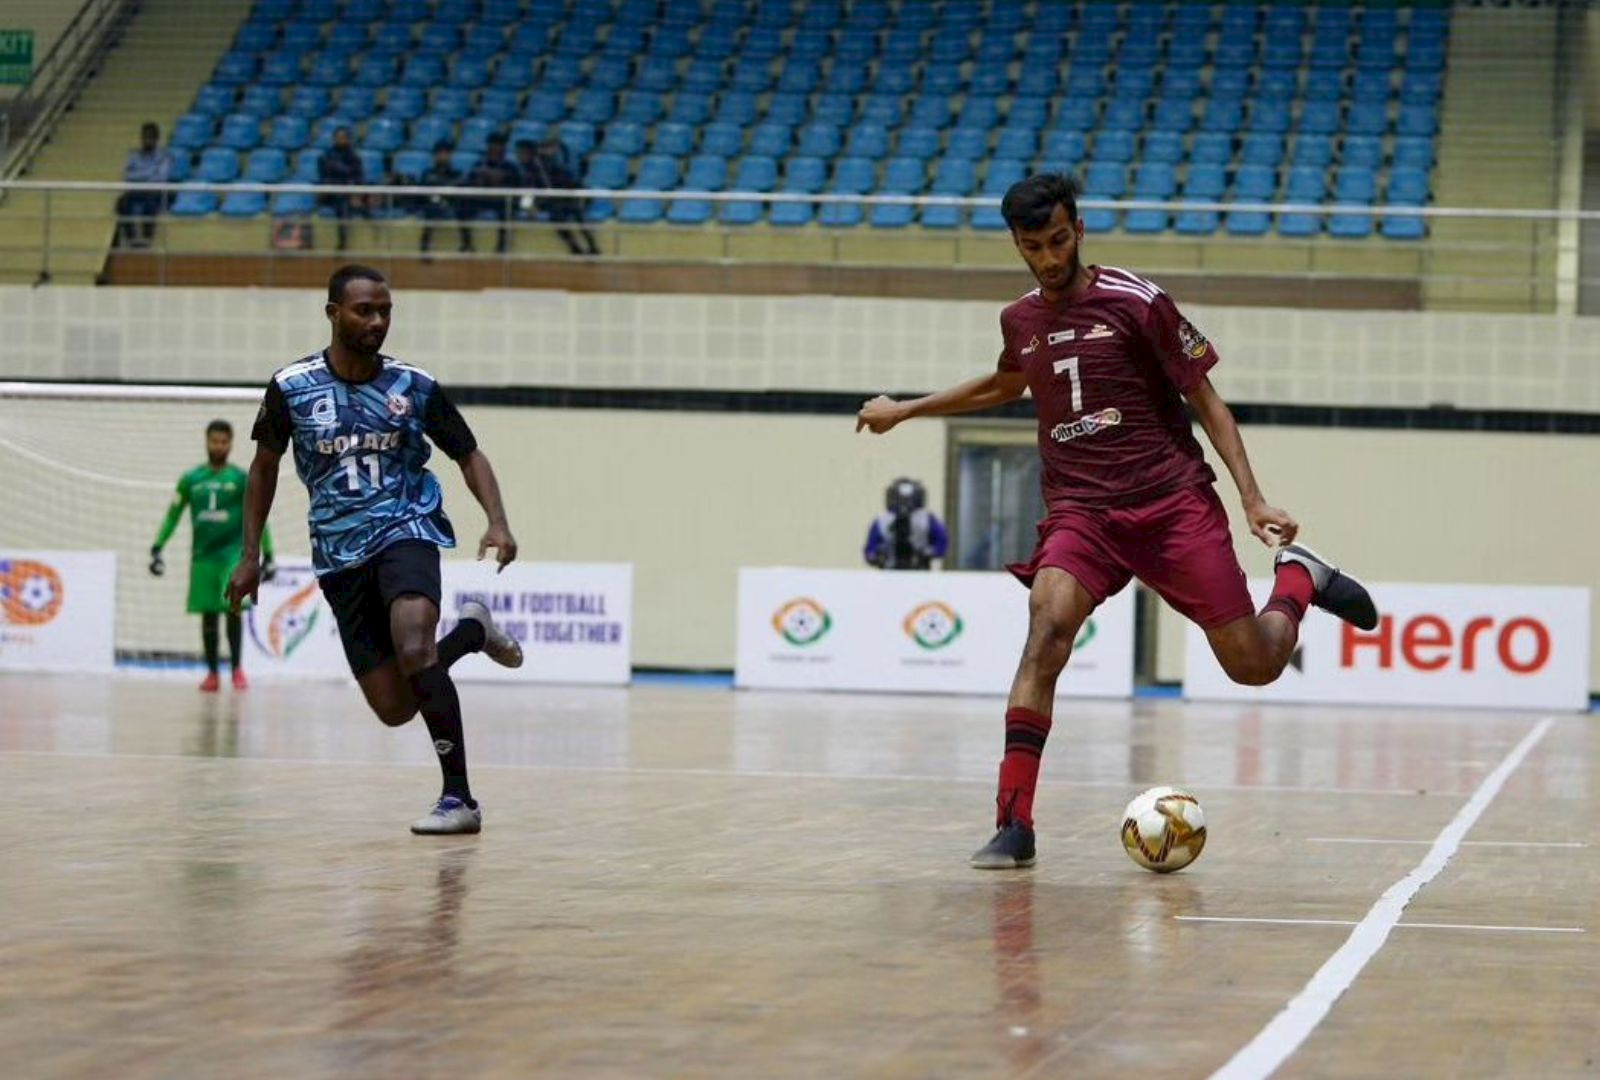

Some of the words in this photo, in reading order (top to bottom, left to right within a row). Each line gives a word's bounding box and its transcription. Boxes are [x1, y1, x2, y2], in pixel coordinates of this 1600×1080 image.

[1052, 356, 1083, 412] 7
[340, 453, 382, 490] 11
[520, 592, 607, 616] FOOTBALL
[533, 620, 622, 643] TOGETHER
[1340, 614, 1553, 674] Hero
